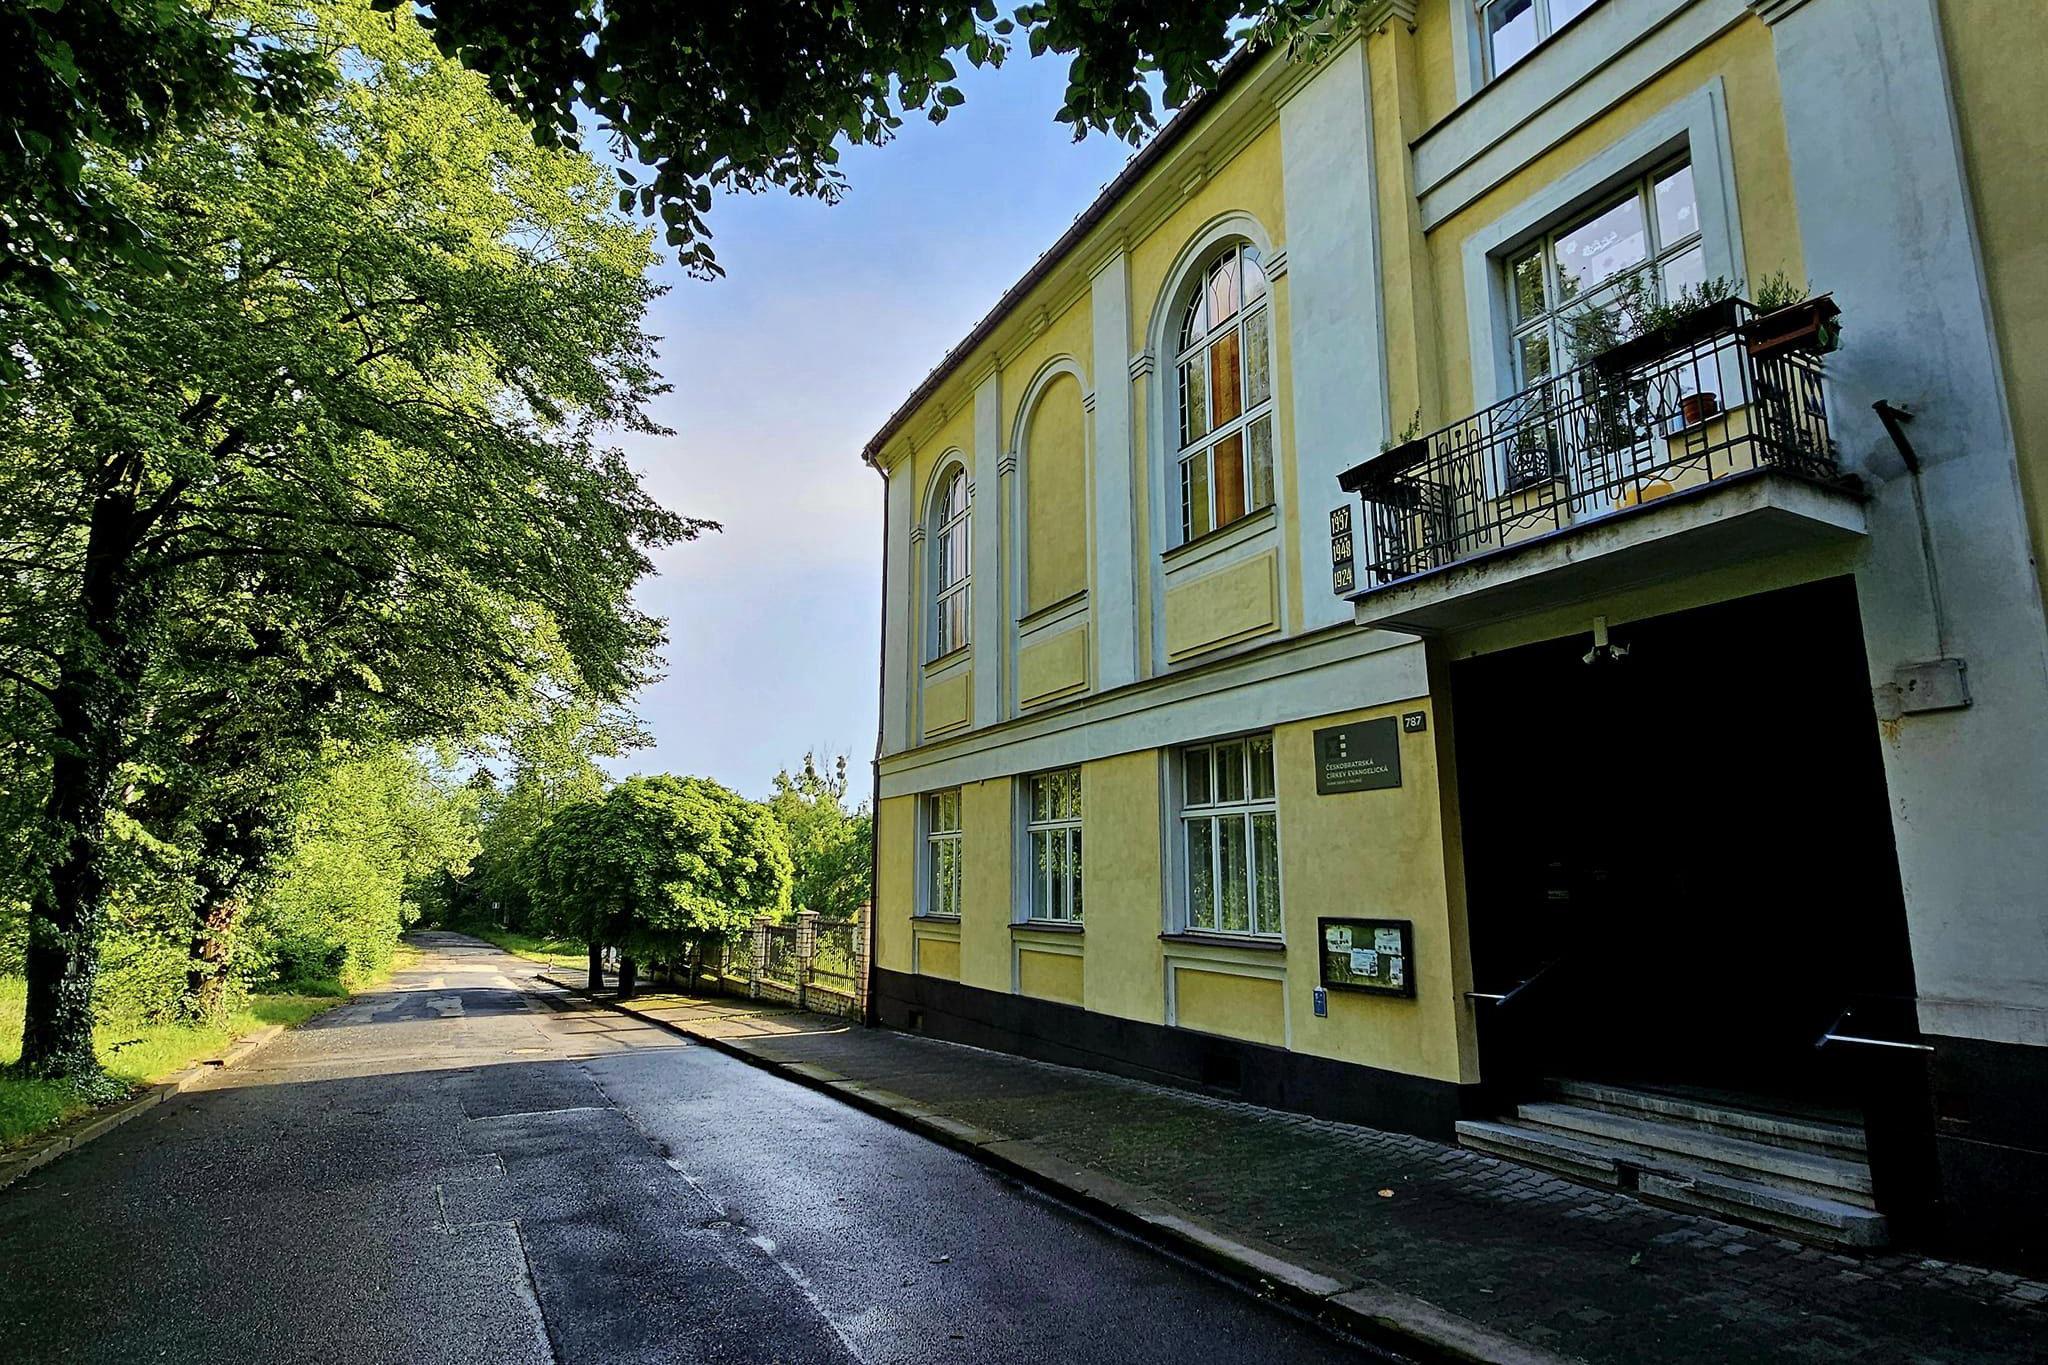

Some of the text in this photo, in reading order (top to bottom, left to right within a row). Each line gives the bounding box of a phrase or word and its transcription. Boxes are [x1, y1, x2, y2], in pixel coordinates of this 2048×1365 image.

[1331, 511, 1349, 534] 1997
[1333, 540, 1351, 562] 1948
[1334, 567, 1352, 589] 1924
[1405, 715, 1422, 728] 787
[1347, 765, 1389, 778] EVANGELICKÁ
